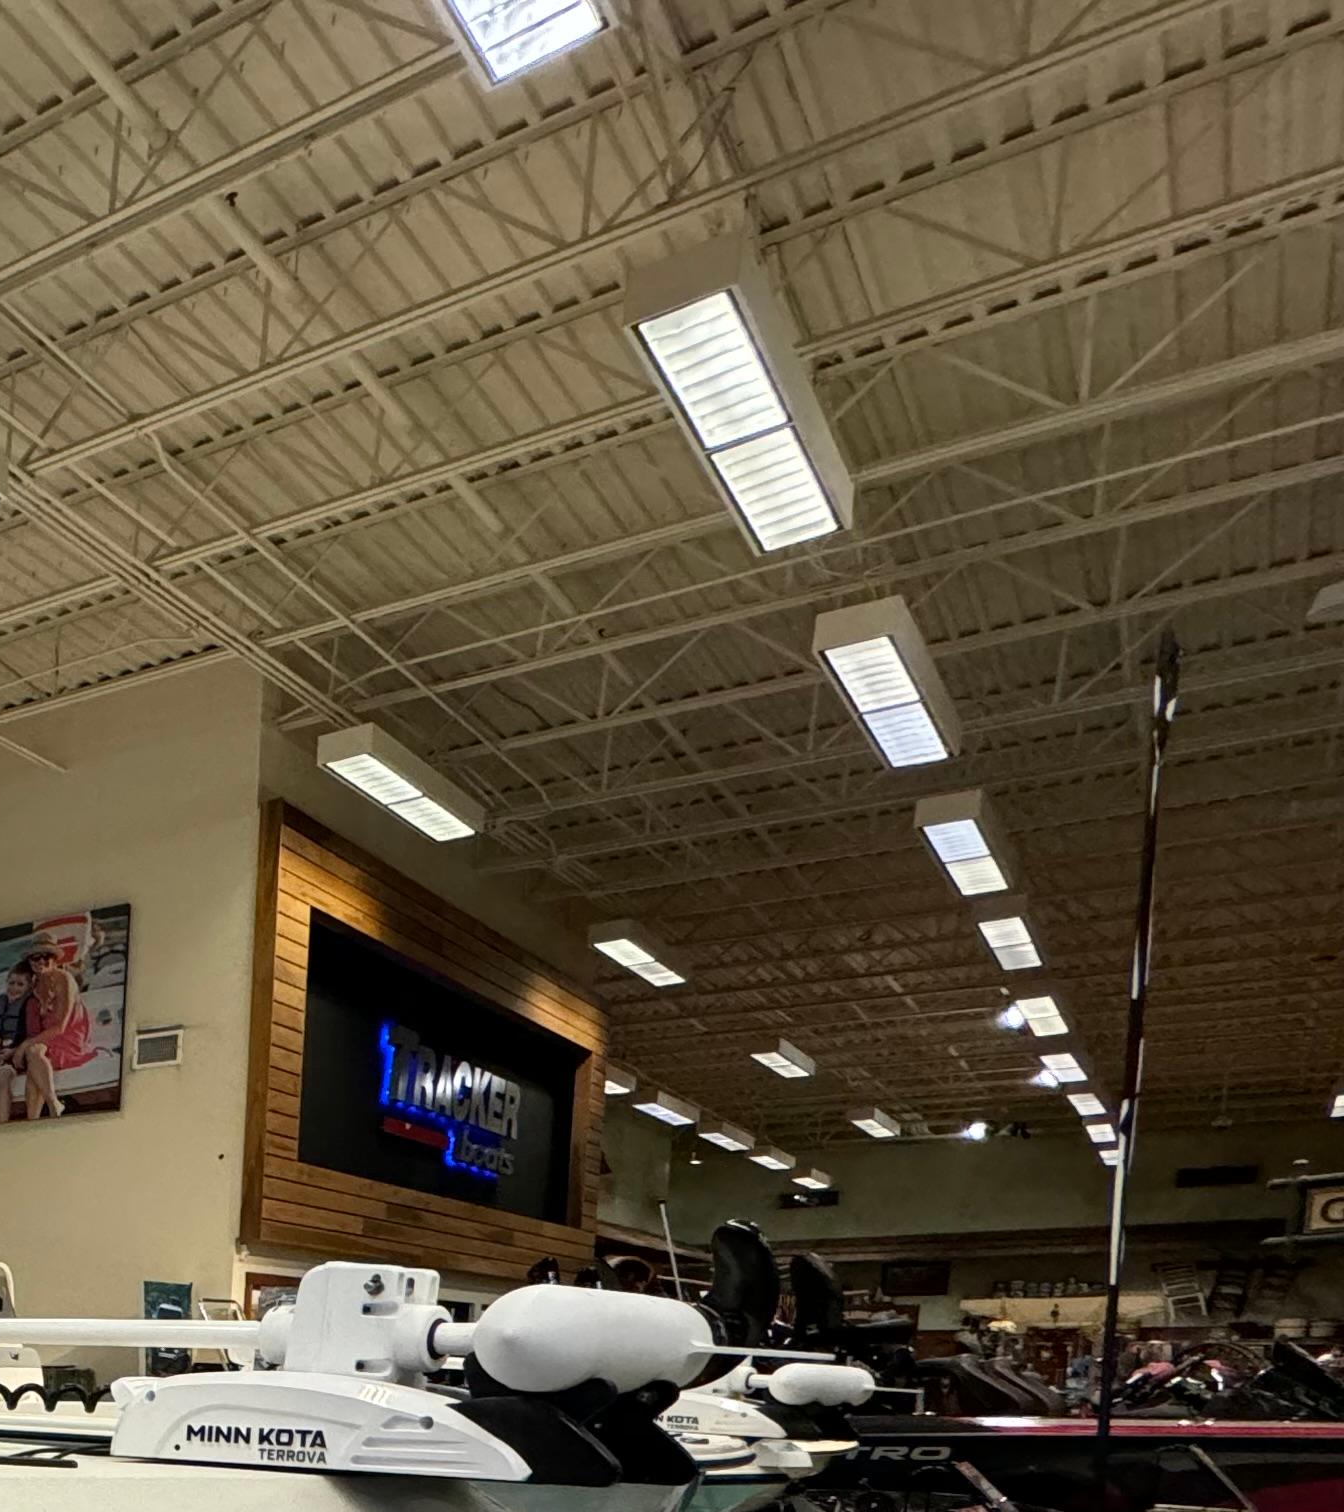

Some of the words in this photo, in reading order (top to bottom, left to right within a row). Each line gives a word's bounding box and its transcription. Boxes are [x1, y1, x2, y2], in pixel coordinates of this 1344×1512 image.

[390, 1025, 521, 1140] TRACKER
[461, 1126, 515, 1176] boats
[186, 1424, 251, 1444] MINN
[258, 1428, 327, 1448] KOTA
[259, 1448, 327, 1464] TERROVA
